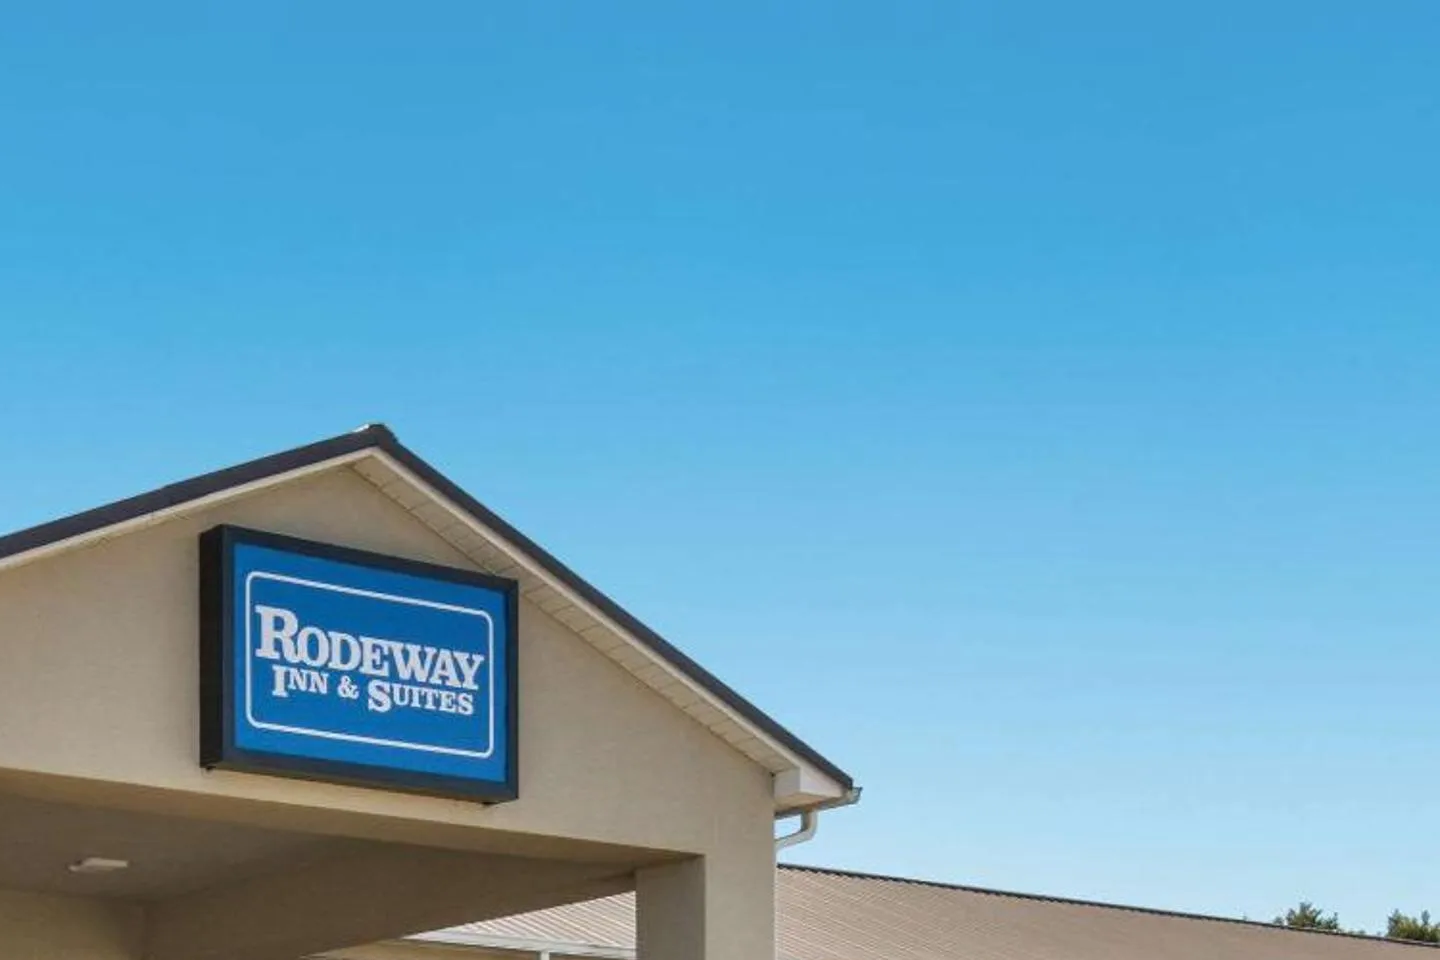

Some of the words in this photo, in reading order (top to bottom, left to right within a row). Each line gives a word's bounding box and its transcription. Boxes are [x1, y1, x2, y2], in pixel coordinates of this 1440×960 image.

[255, 605, 484, 690] RODEWAY
[272, 665, 328, 697] INN
[337, 676, 359, 700] &
[367, 679, 473, 716] SUITES
